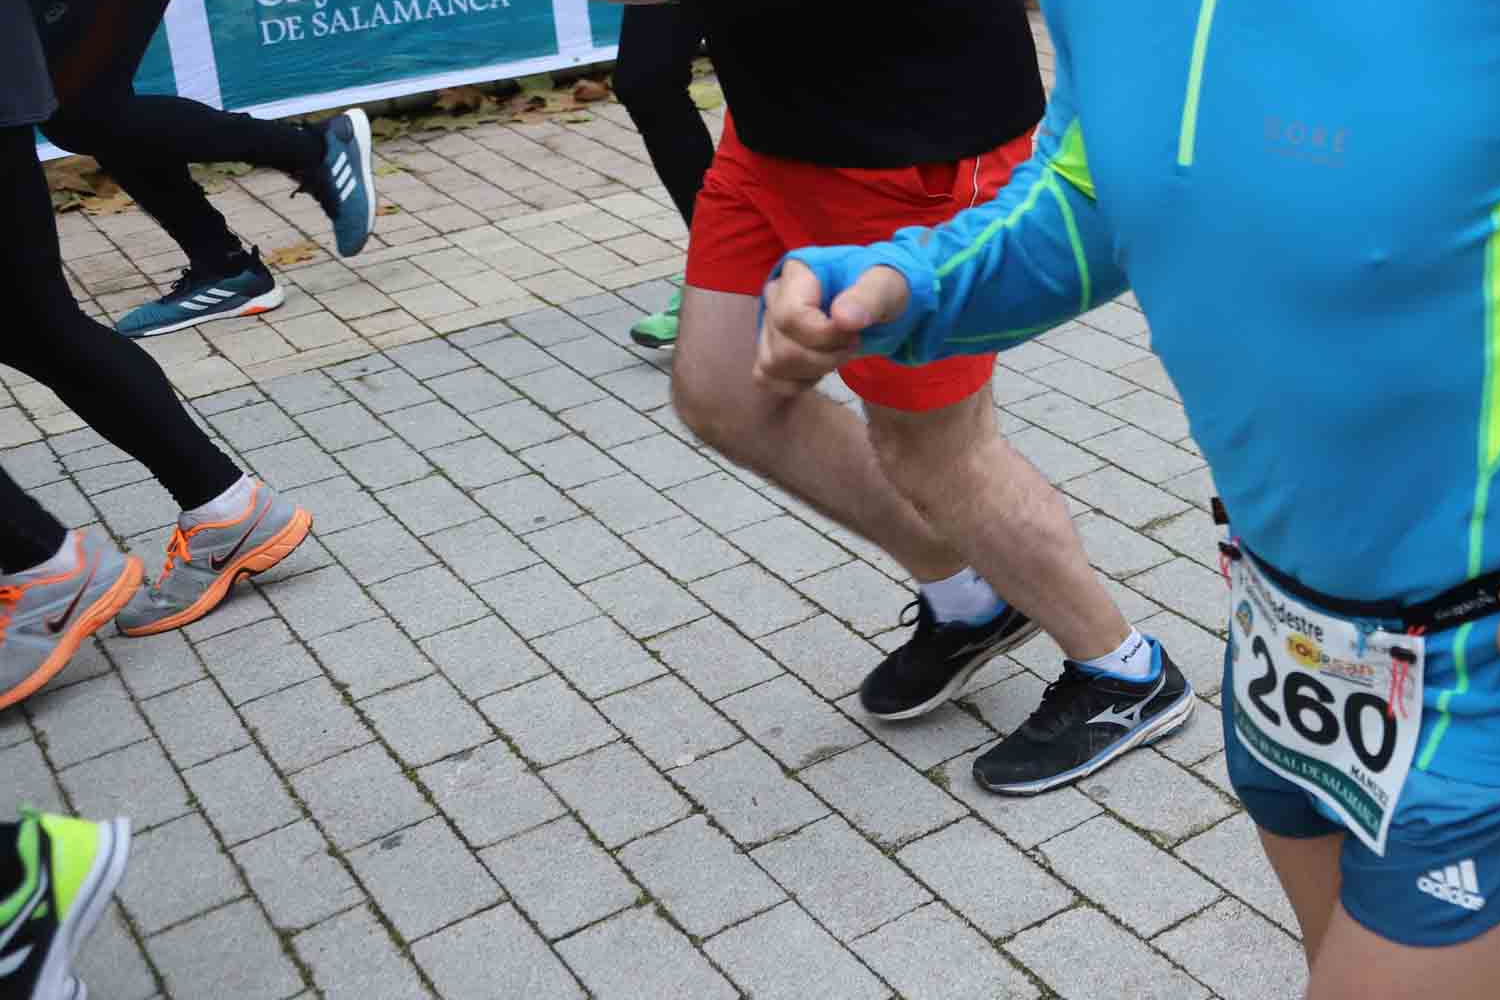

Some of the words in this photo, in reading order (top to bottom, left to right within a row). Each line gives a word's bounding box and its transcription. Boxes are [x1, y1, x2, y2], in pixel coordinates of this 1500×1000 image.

[260, 16, 304, 45] DE
[1268, 598, 1324, 644] destre
[1247, 635, 1398, 774] 260
[1416, 876, 1487, 911] adidas
